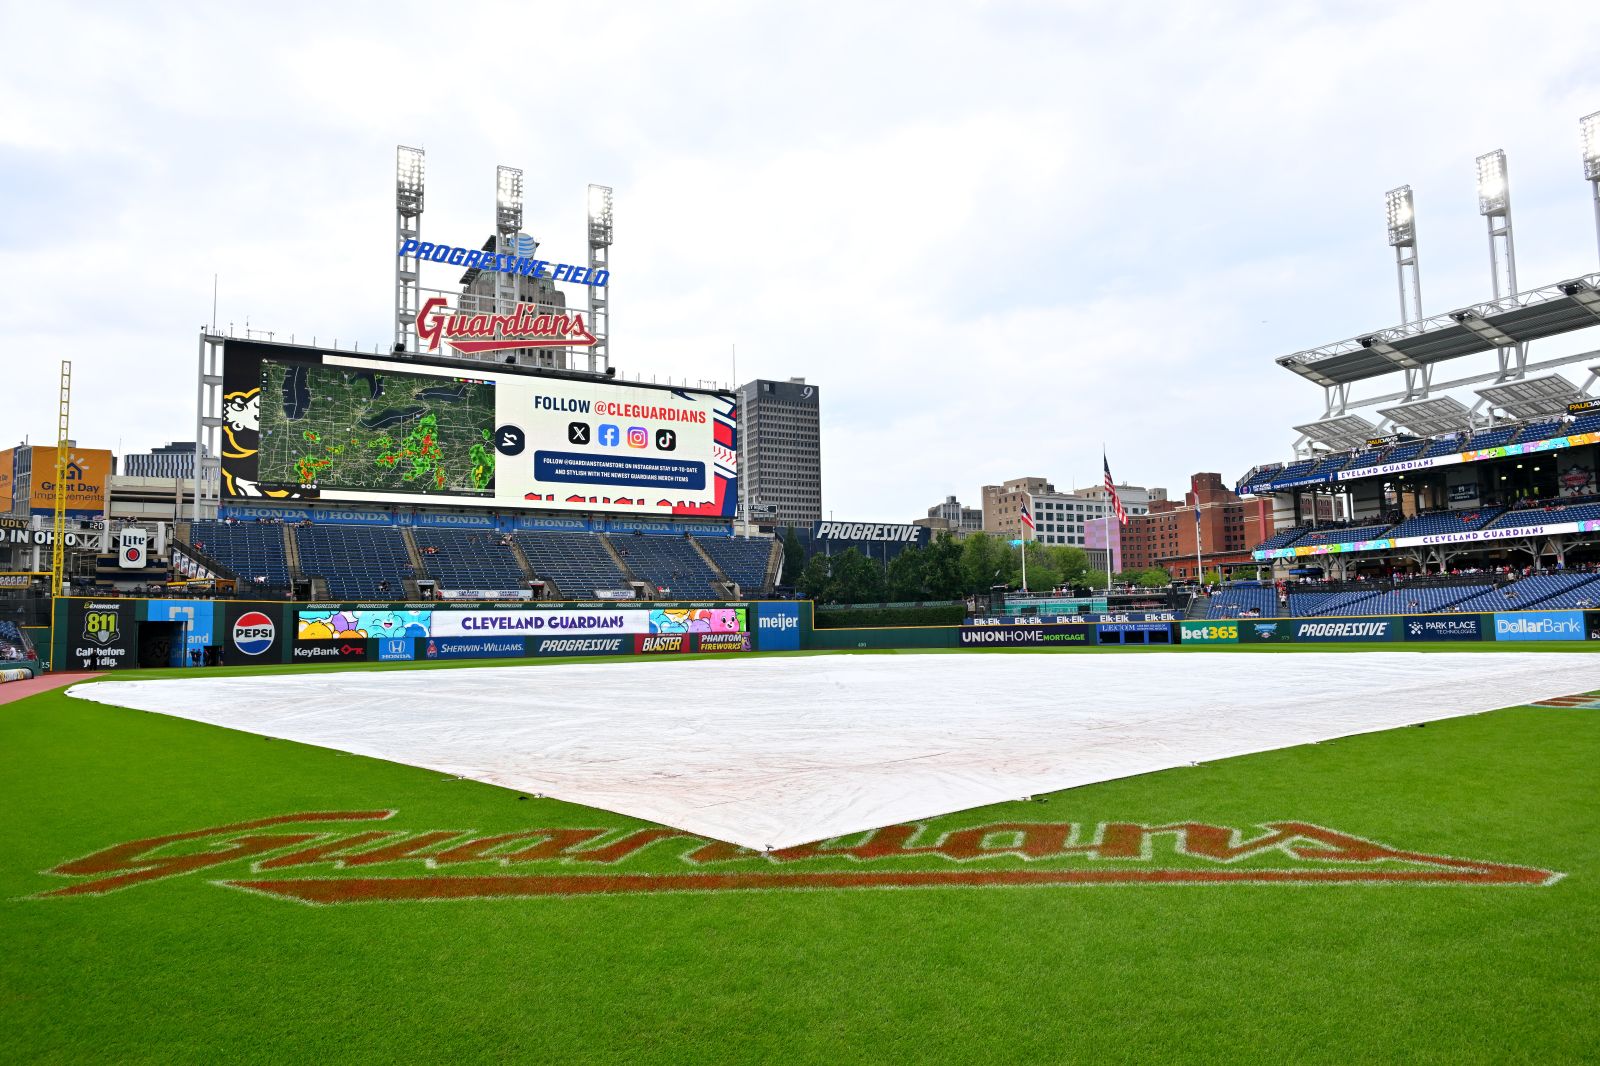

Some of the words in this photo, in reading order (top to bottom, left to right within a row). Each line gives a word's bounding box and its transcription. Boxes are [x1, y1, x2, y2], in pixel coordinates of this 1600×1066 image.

[399, 239, 549, 278] PROGRESSIVE
[552, 263, 610, 287] FIELD
[416, 297, 598, 354] Guardians
[535, 395, 590, 414] FOLLOW
[594, 400, 706, 424] @CLEGUARDIANS
[563, 459, 625, 468] @GUARDIANSTEAMSTORE
[1339, 468, 1378, 479] EVELAND
[1382, 459, 1434, 473] GUARDIANS
[77, 483, 99, 493] Day
[244, 509, 310, 519] HONDA
[329, 511, 390, 521] HONDA
[435, 516, 491, 525] HONDA
[534, 519, 585, 528] HONDA
[623, 522, 670, 531] HONDA
[684, 525, 729, 533] HONDA
[10, 529, 29, 544] IN
[816, 522, 921, 542] PROGRESSIVE
[1422, 532, 1478, 544] CLEVELAND
[1483, 527, 1544, 539] GUARDIANS
[122, 534, 145, 547] Lite
[87, 613, 116, 633] 811
[461, 616, 545, 630] CLEVELAND
[547, 615, 624, 629] GUARDIANS
[759, 613, 799, 631] meijer
[1425, 621, 1447, 629] PARK
[1448, 620, 1476, 629] PLACE
[1497, 618, 1580, 633] DollarBank
[236, 628, 272, 638] PEPSI
[1181, 625, 1238, 639] bet365
[1298, 622, 1388, 637] PROGRESSIVE
[701, 633, 742, 642] PHANTOM
[1043, 633, 1086, 641] MORTGAGE
[539, 639, 621, 652] PROGRESSIVE
[642, 636, 682, 652] BLASTER
[701, 642, 742, 651] FIREWORKS
[76, 647, 94, 657] Call
[96, 647, 125, 656] before
[294, 647, 339, 658] KeyBank
